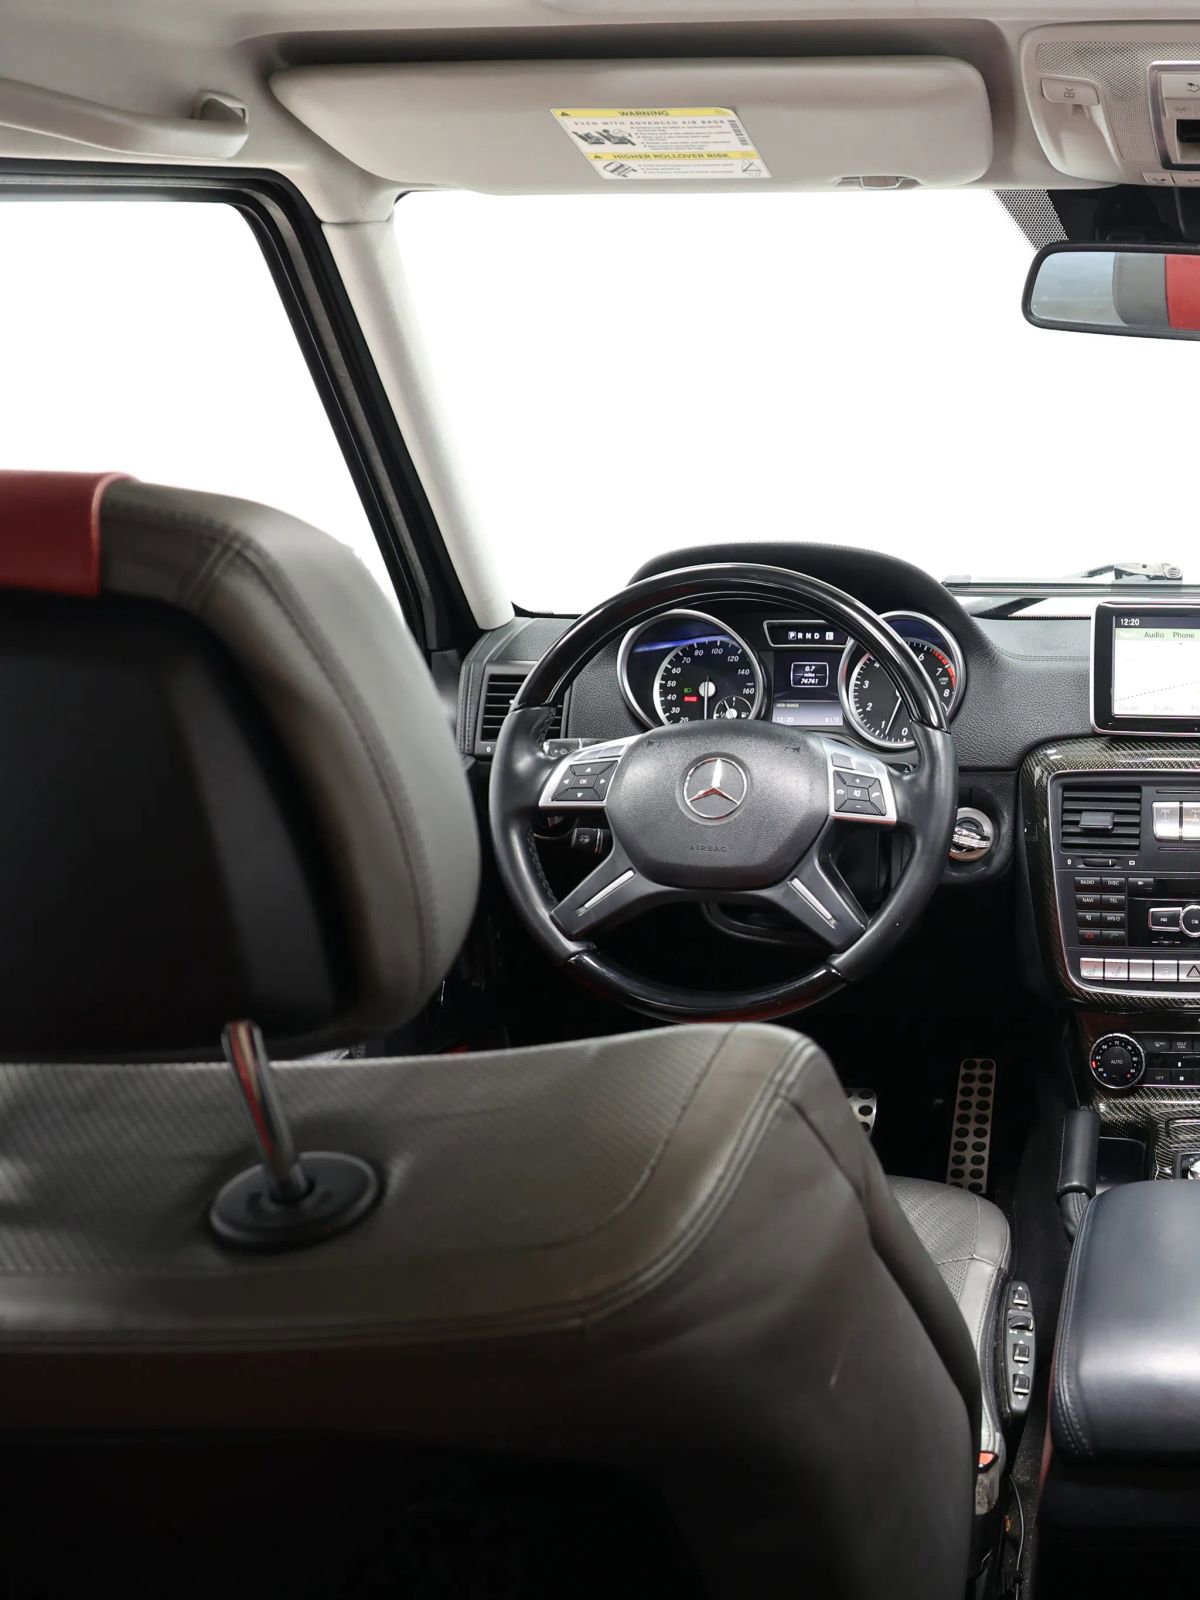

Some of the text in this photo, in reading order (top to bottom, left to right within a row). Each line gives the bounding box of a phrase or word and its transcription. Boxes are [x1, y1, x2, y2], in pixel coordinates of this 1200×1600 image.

[1120, 618, 1140, 626] 12:20
[936, 668, 942, 676] 7
[943, 689, 950, 697] 8
